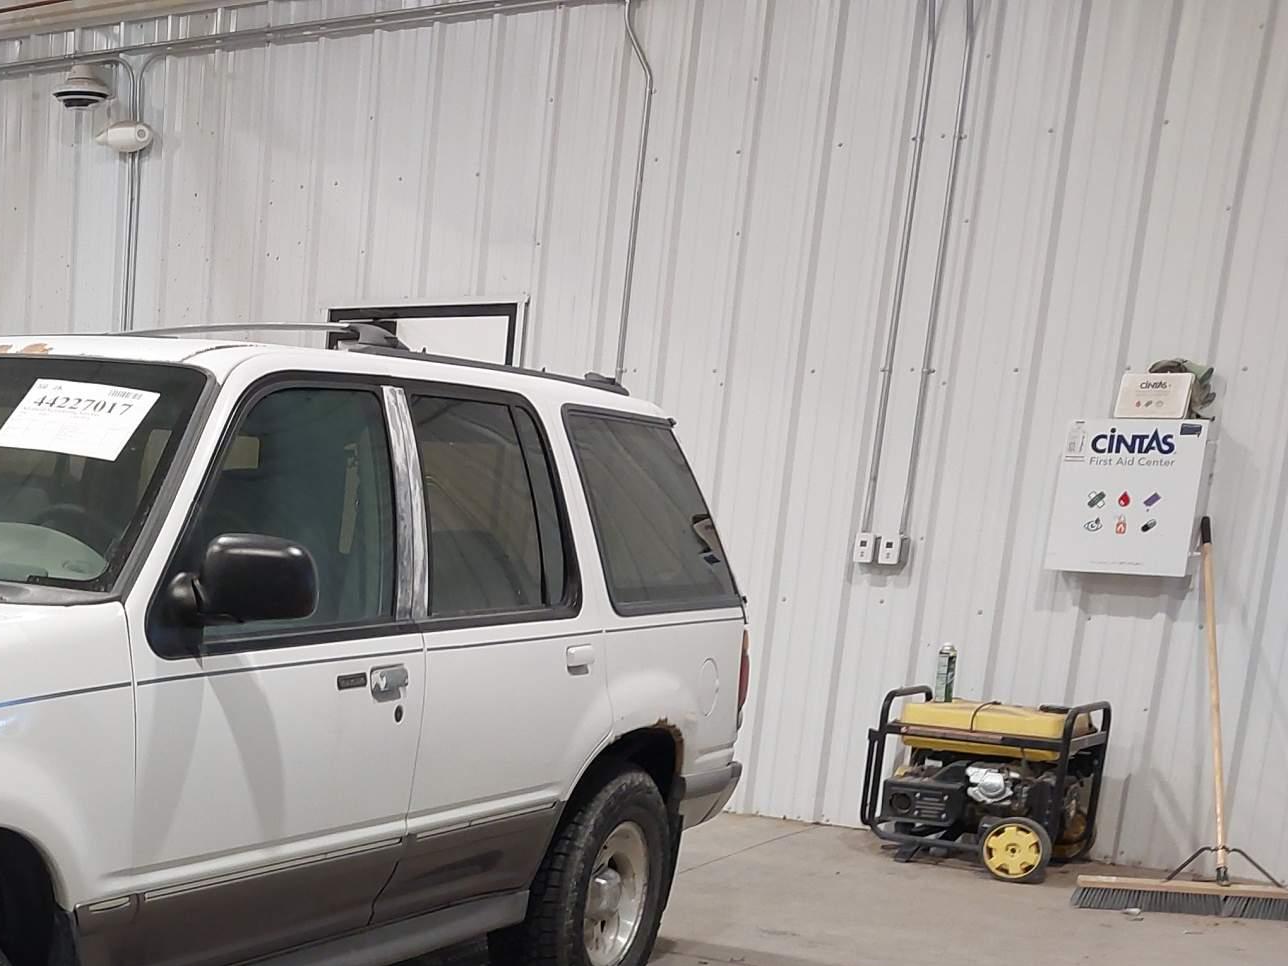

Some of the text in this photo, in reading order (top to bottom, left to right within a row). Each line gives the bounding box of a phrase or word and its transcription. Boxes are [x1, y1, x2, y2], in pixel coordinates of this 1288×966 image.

[33, 395, 133, 415] 44227017
[1089, 456, 1176, 467] First Aid Center
